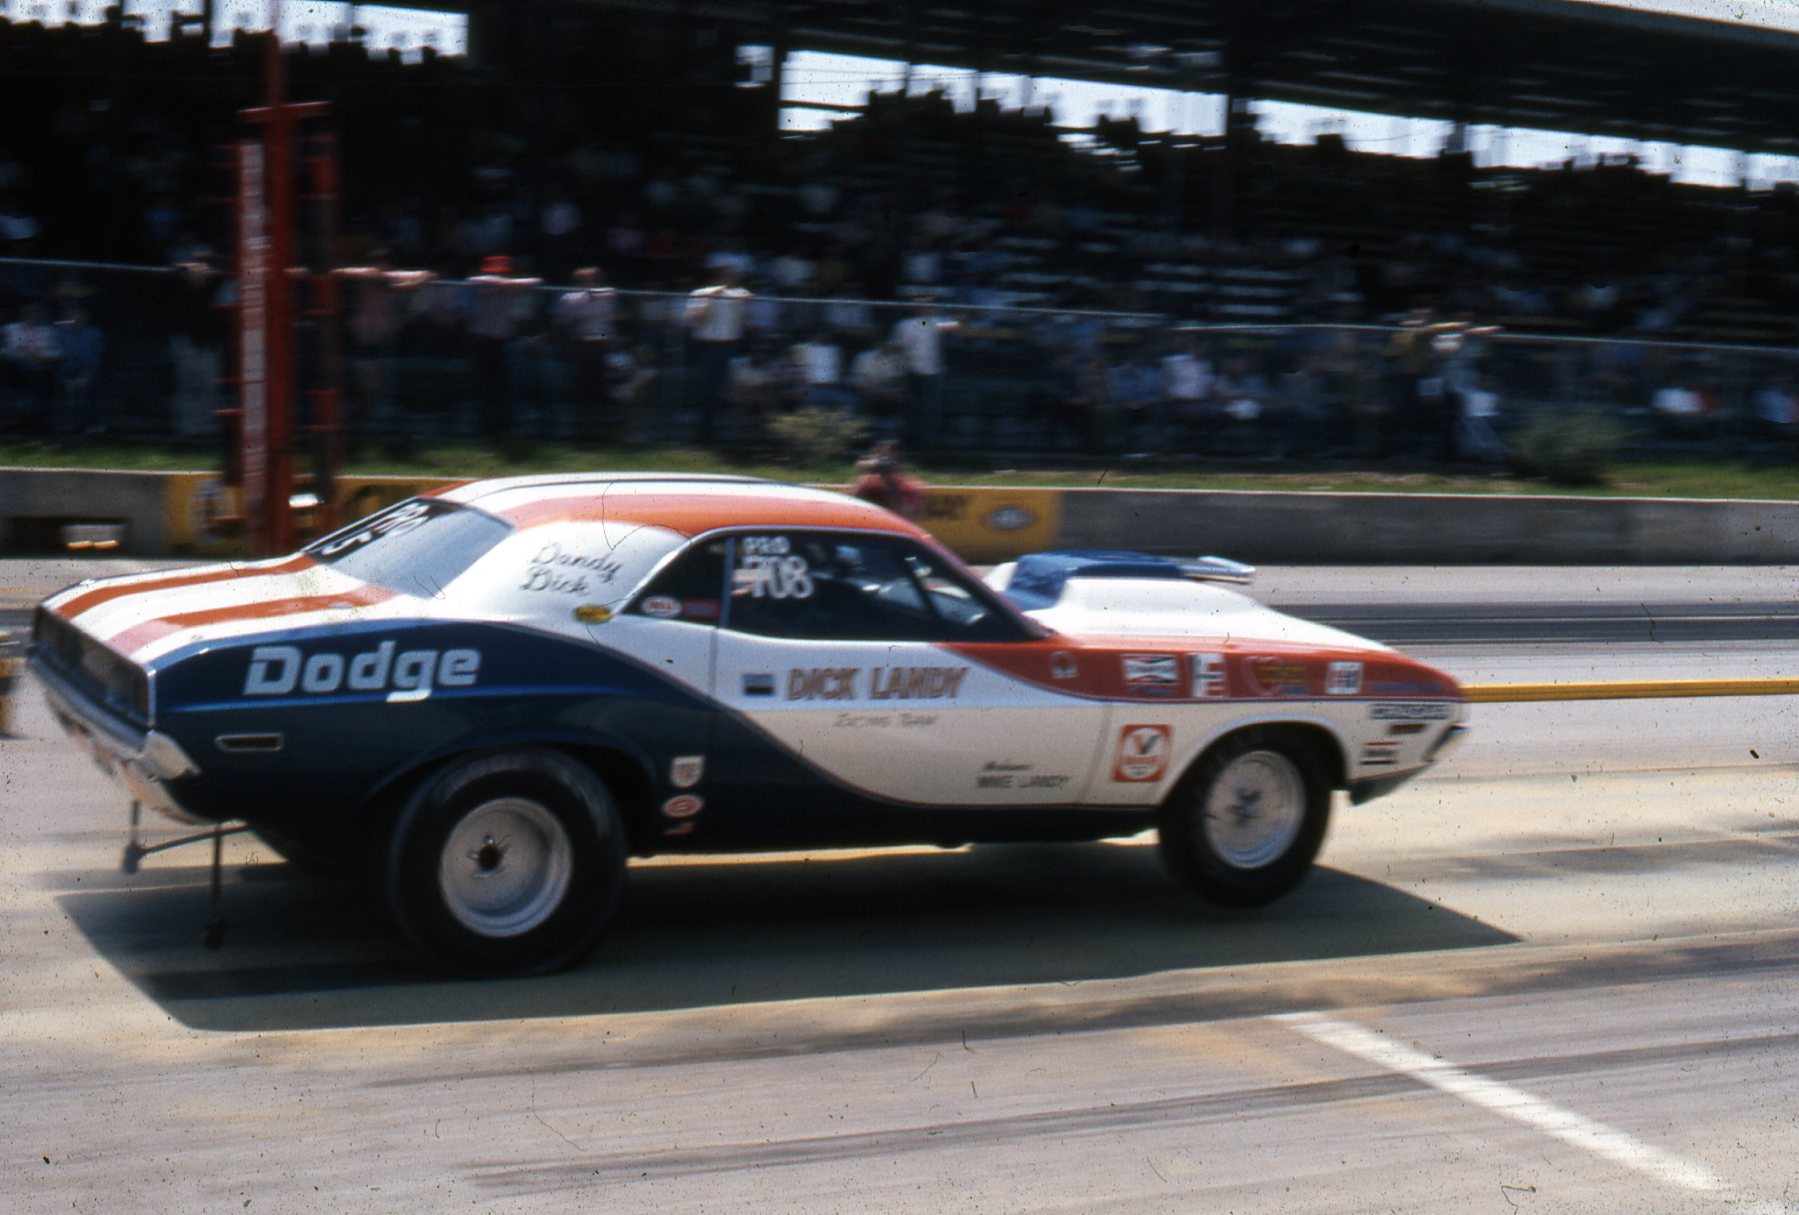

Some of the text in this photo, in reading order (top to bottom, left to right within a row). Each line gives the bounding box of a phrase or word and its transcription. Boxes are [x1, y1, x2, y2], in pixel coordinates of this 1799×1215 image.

[519, 565, 591, 597] Dick
[532, 542, 624, 583] Dandy
[243, 640, 480, 703] Dodge
[787, 667, 861, 701] DICK
[868, 667, 970, 700] LANDY
